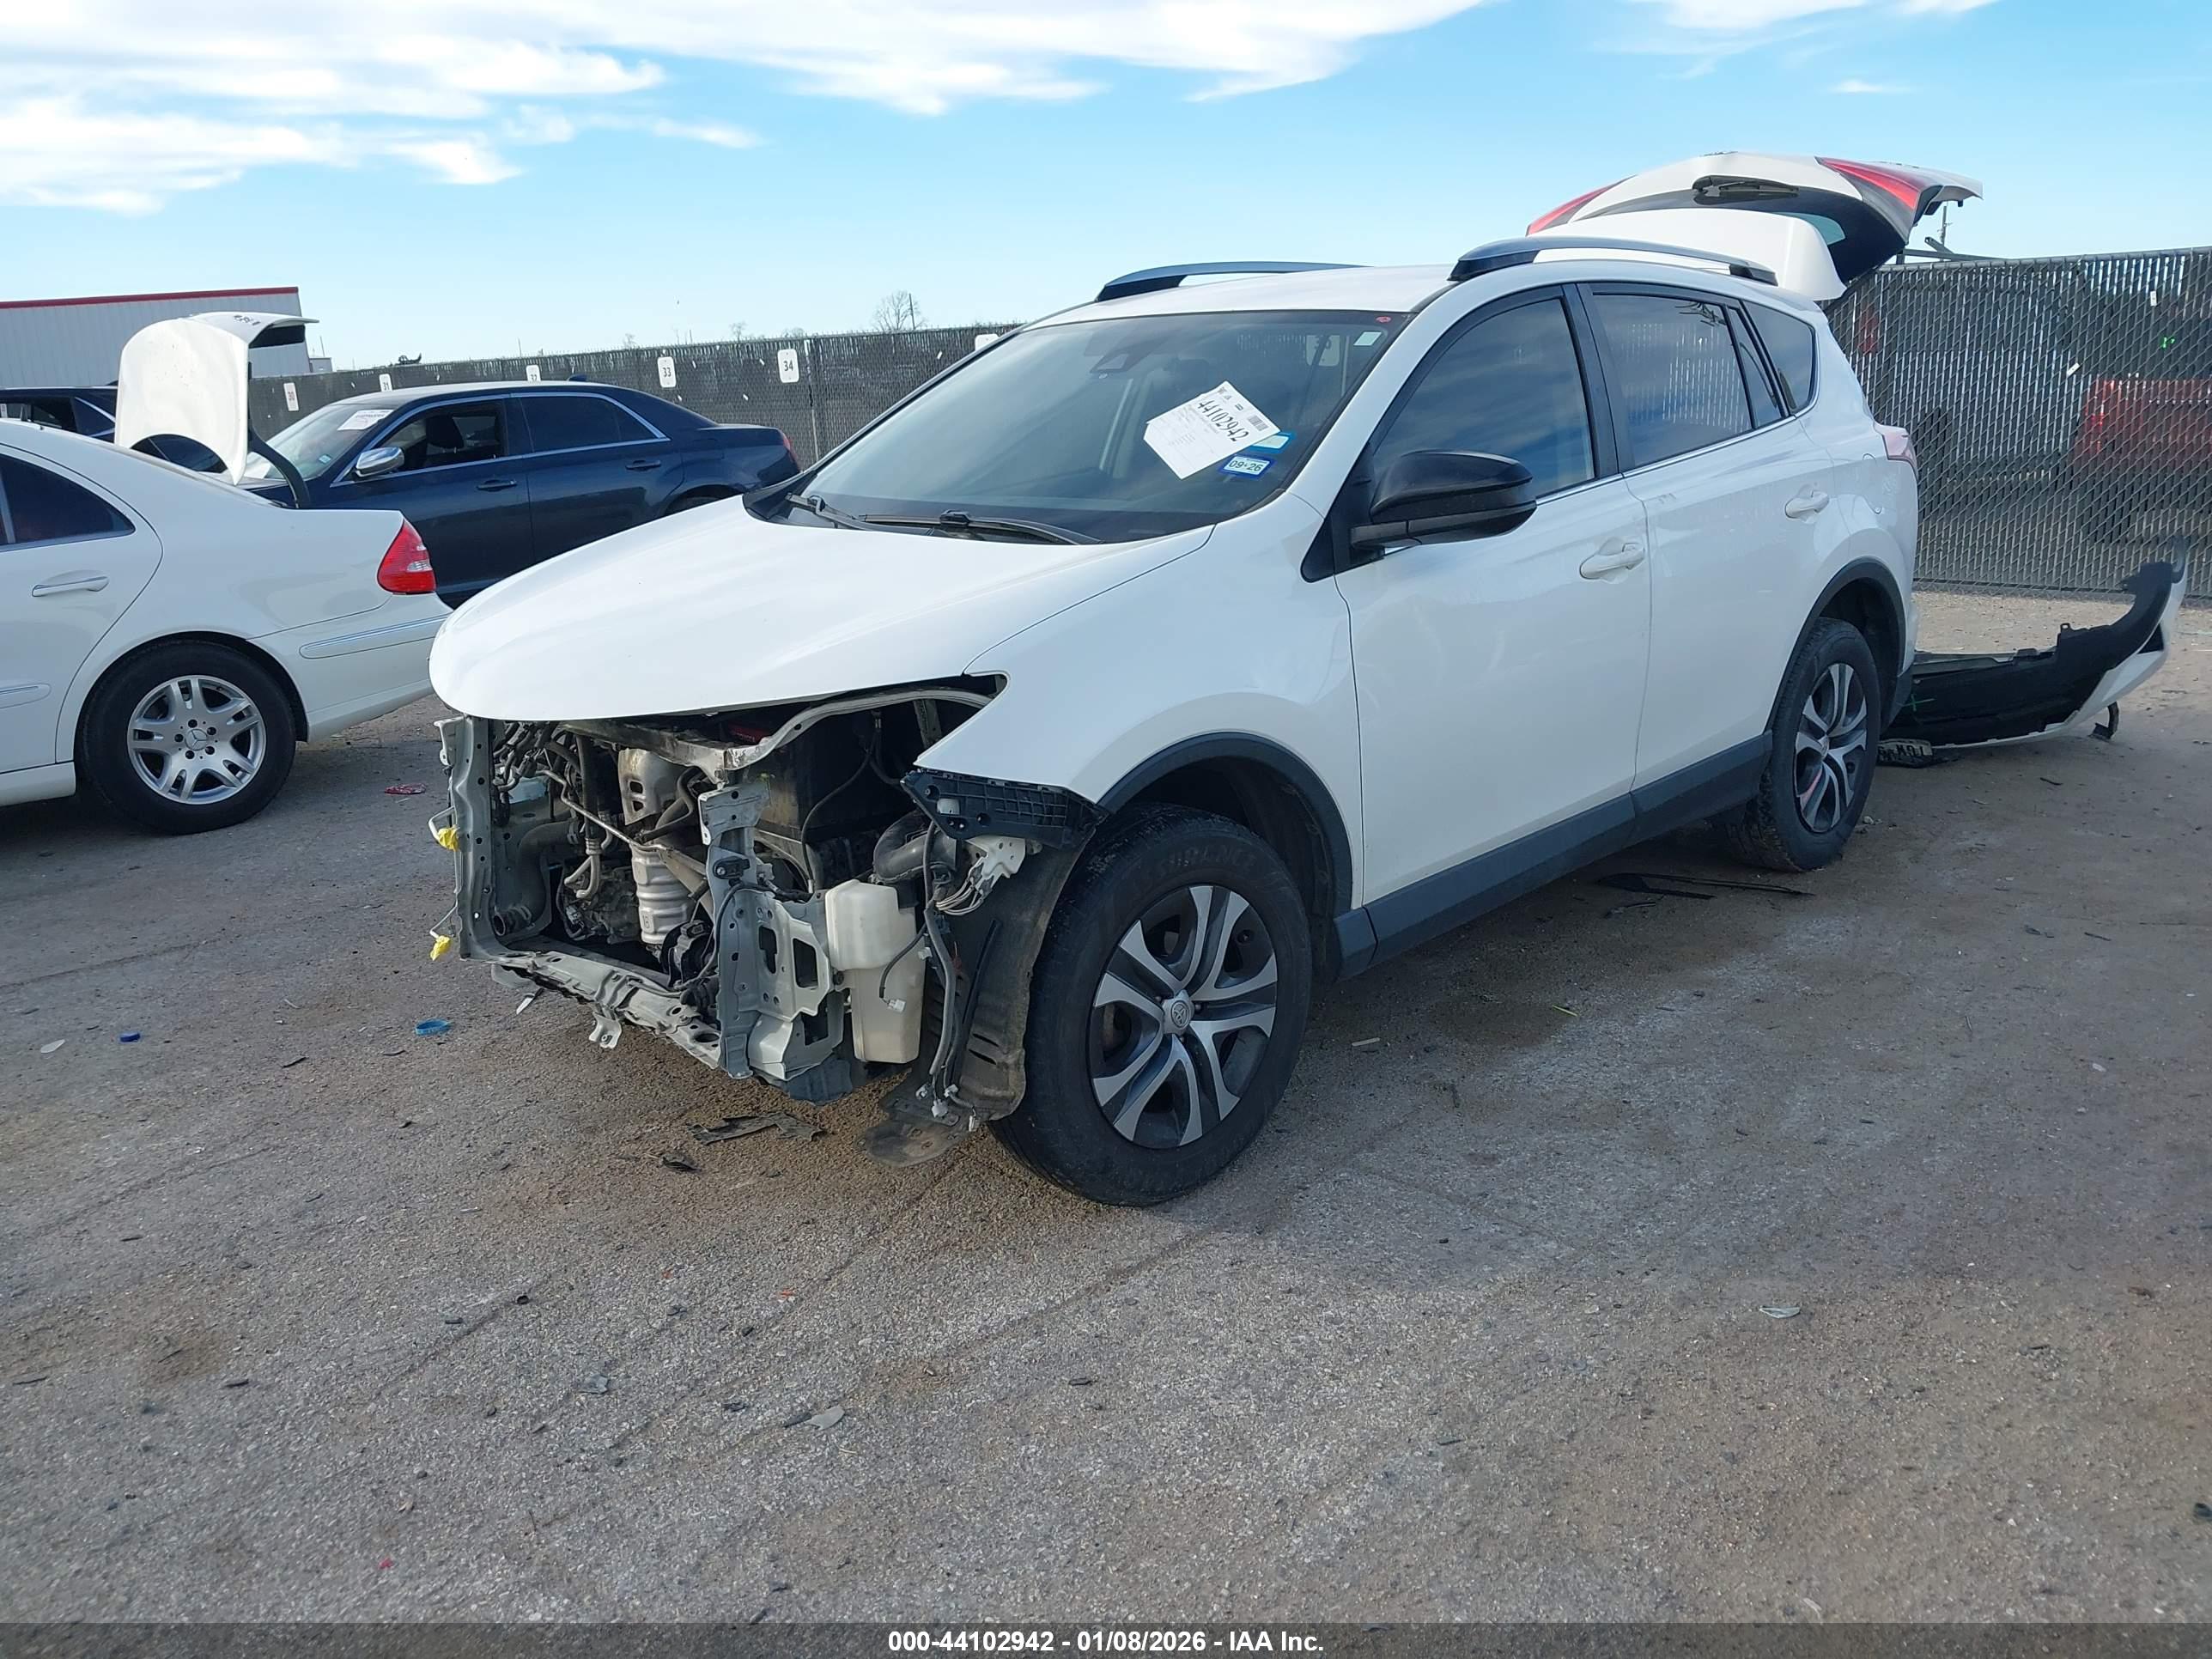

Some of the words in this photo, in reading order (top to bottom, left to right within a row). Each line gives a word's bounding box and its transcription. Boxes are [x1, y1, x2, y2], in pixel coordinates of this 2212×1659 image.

[783, 360, 793, 372] 34
[662, 367, 672, 378] 33
[1197, 399, 1249, 442] 44102942
